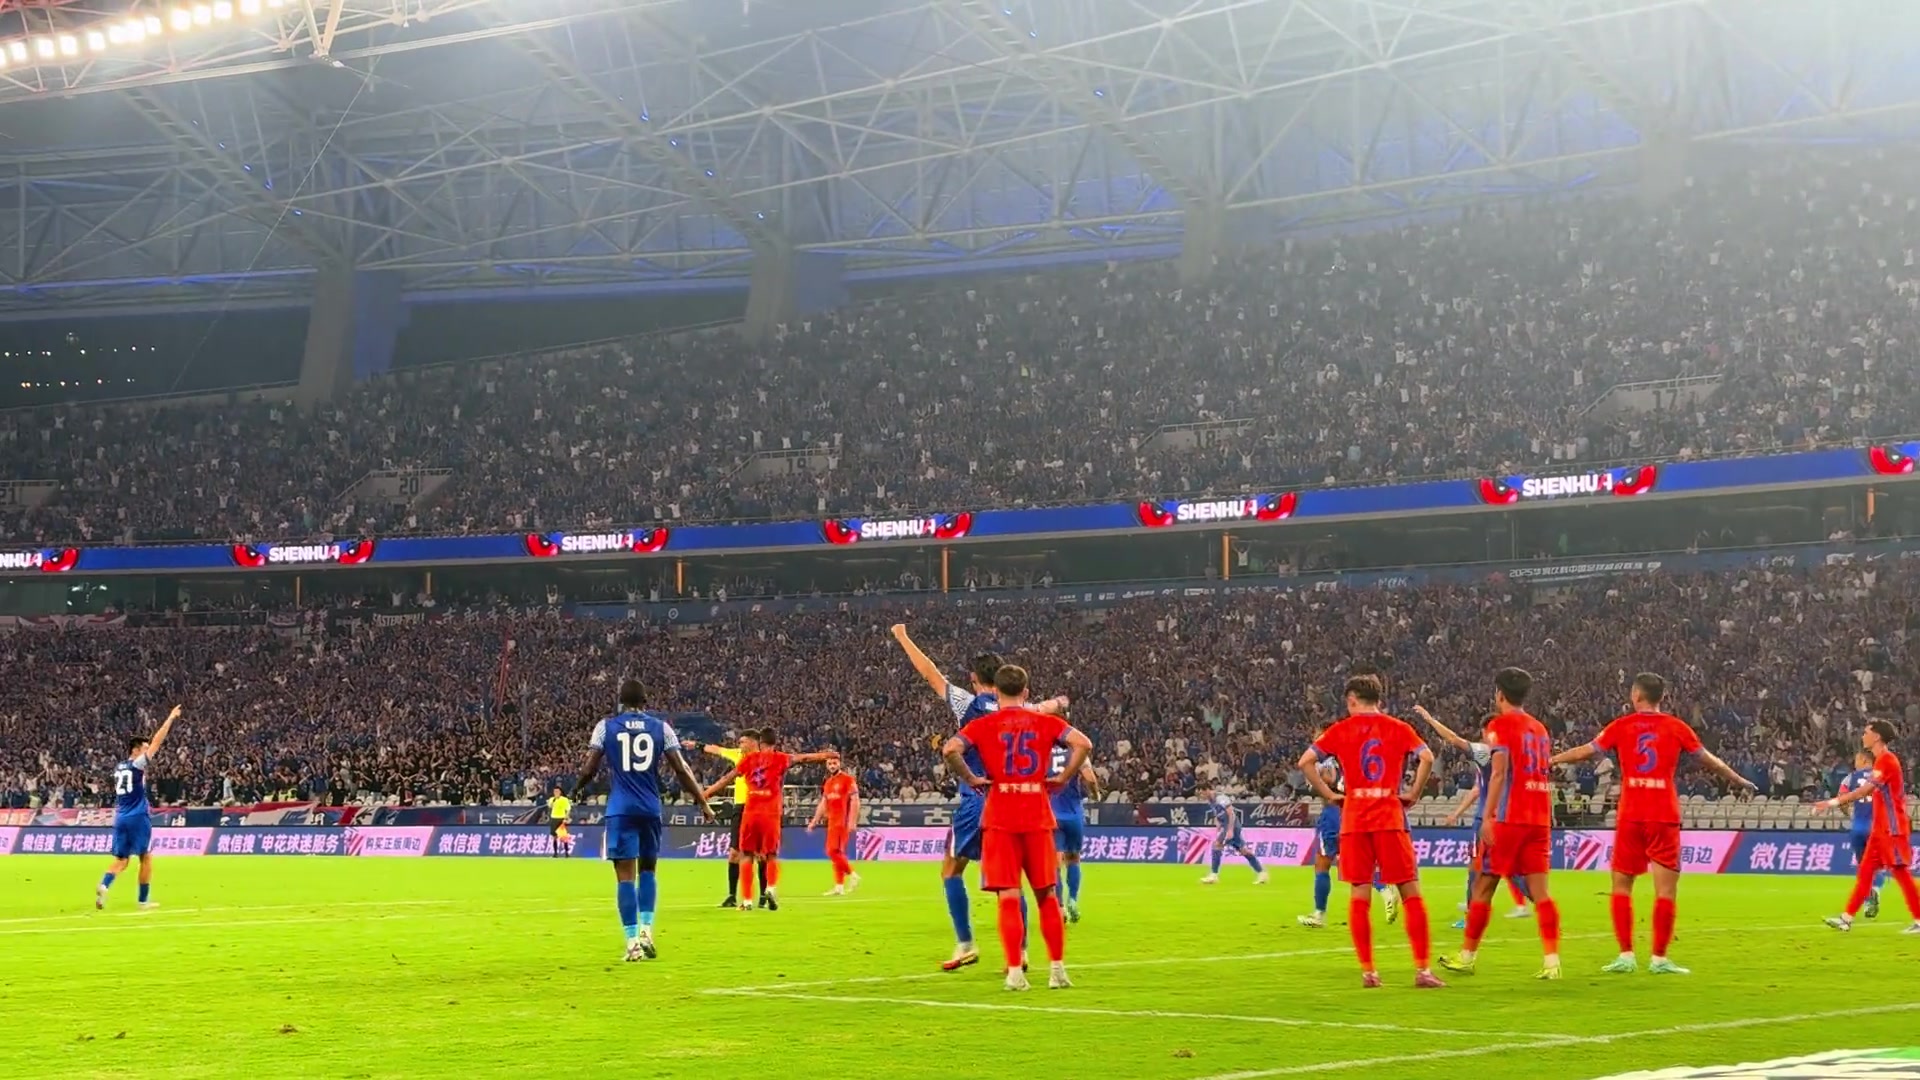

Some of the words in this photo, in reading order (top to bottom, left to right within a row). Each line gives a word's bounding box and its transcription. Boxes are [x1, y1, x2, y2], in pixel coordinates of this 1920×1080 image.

[1652, 388, 1679, 413] 17
[1194, 430, 1215, 446] 18
[399, 477, 419, 496] 20
[1522, 473, 1613, 497] SHENHUA
[1177, 499, 1258, 520] SHENHUA
[861, 518, 936, 538] SHENHUA
[561, 533, 635, 551] SHENHUA
[268, 545, 340, 562] SHENHUA
[617, 732, 654, 771] 19
[1000, 732, 1039, 777] 15
[1360, 738, 1386, 782] 6
[1636, 732, 1659, 773] 5
[114, 769, 133, 796] 27
[365, 837, 421, 851] 购买正版周边
